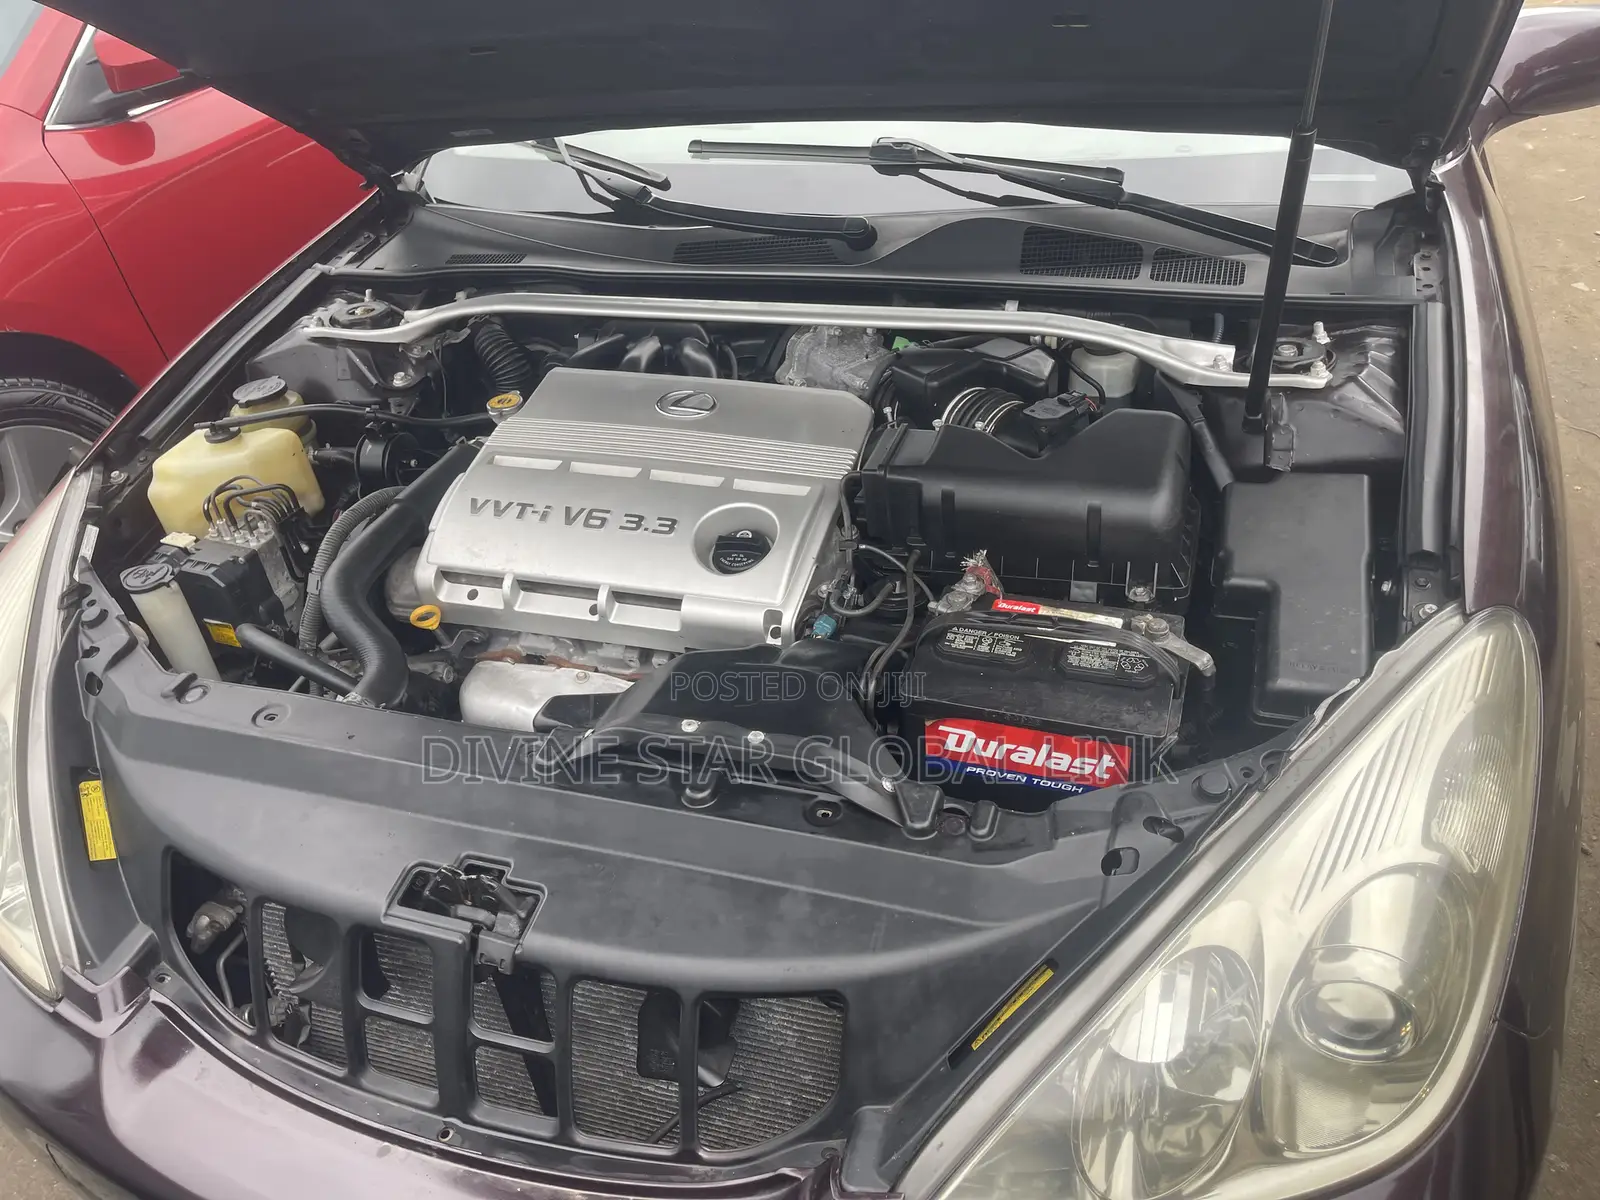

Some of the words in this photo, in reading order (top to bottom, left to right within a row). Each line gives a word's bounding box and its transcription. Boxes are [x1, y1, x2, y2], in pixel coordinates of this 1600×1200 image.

[470, 497, 553, 522] VVT-i
[564, 506, 611, 529] V6
[618, 513, 679, 535] 3.3
[997, 602, 1036, 613] Duralast
[958, 627, 987, 636] DANGER
[993, 632, 1020, 640] POISON
[938, 725, 1116, 780] Duralast
[966, 766, 1027, 784] PROVEN
[1032, 777, 1083, 793] TOUGH
